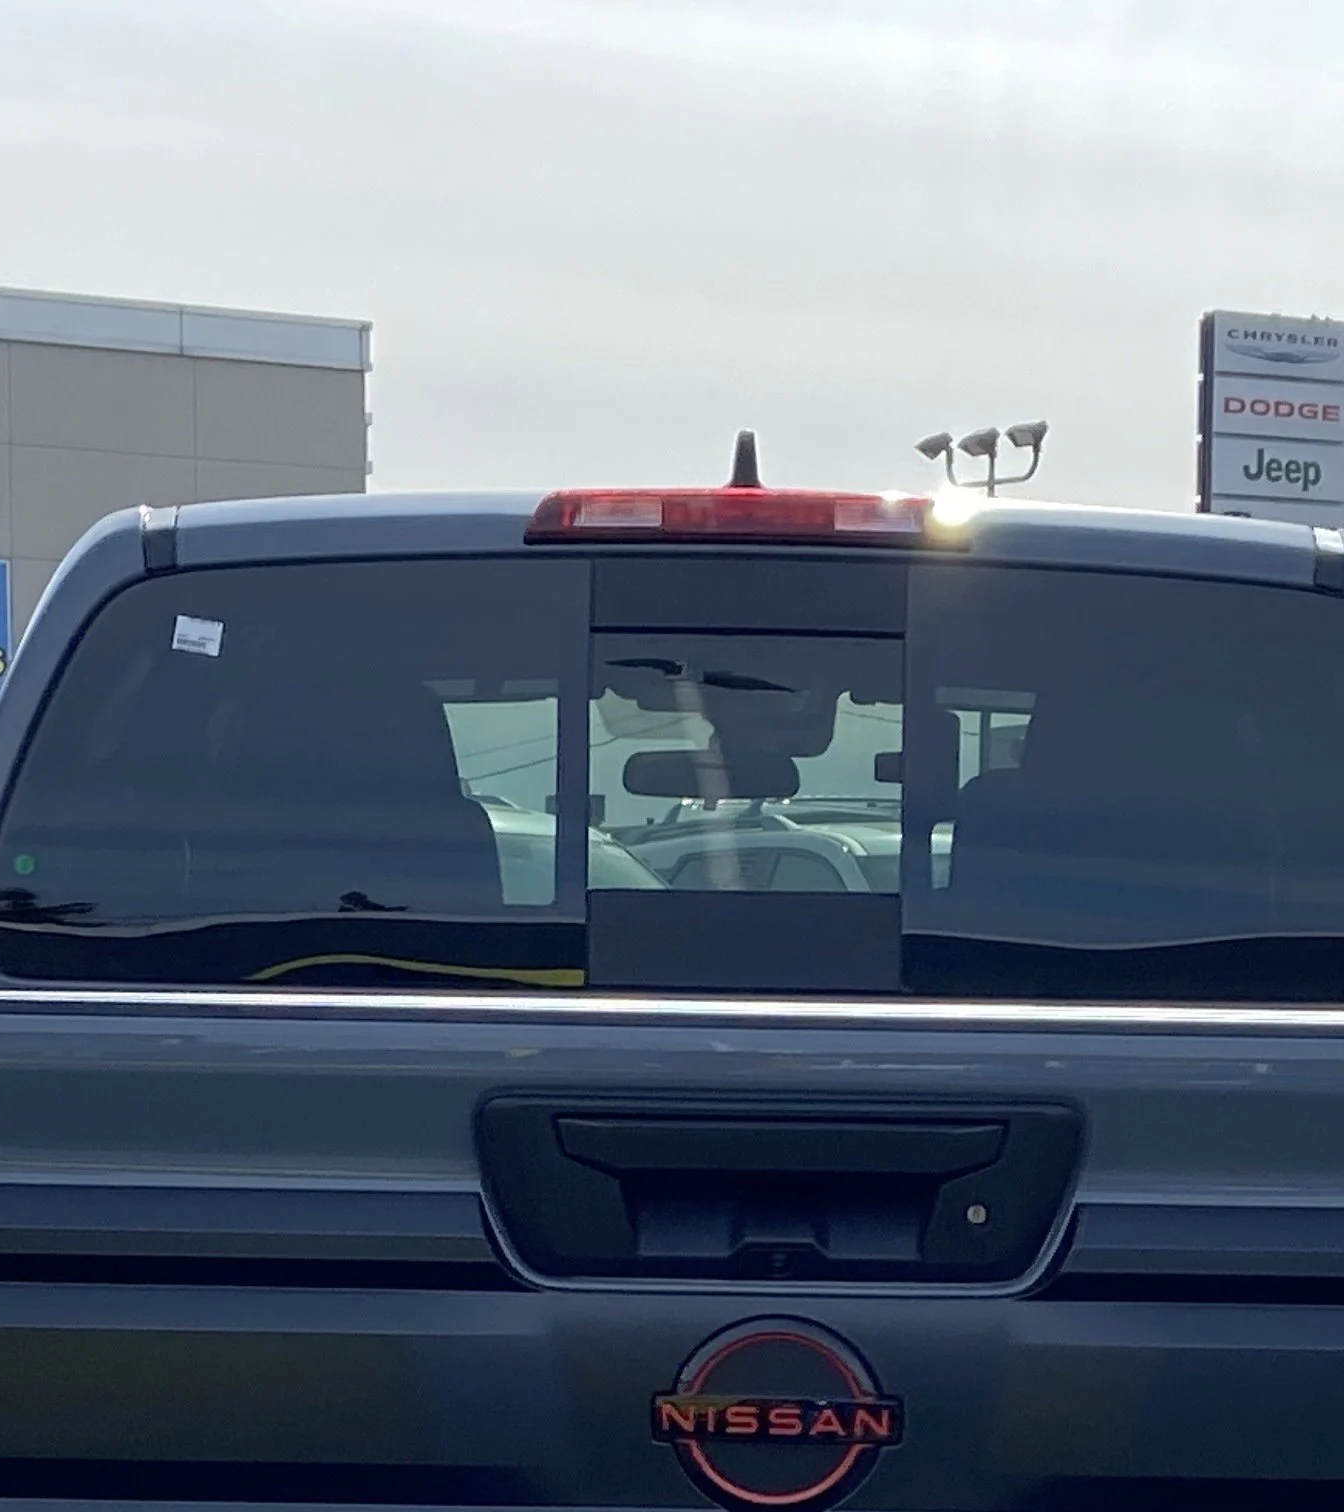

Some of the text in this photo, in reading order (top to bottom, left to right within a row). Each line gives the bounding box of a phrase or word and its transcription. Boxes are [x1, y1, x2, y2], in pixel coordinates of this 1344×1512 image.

[1227, 328, 1338, 347] CHRYSLER
[1223, 397, 1340, 422] DODGE
[1243, 448, 1322, 491] Jeep
[661, 1403, 890, 1437] NISSAN
